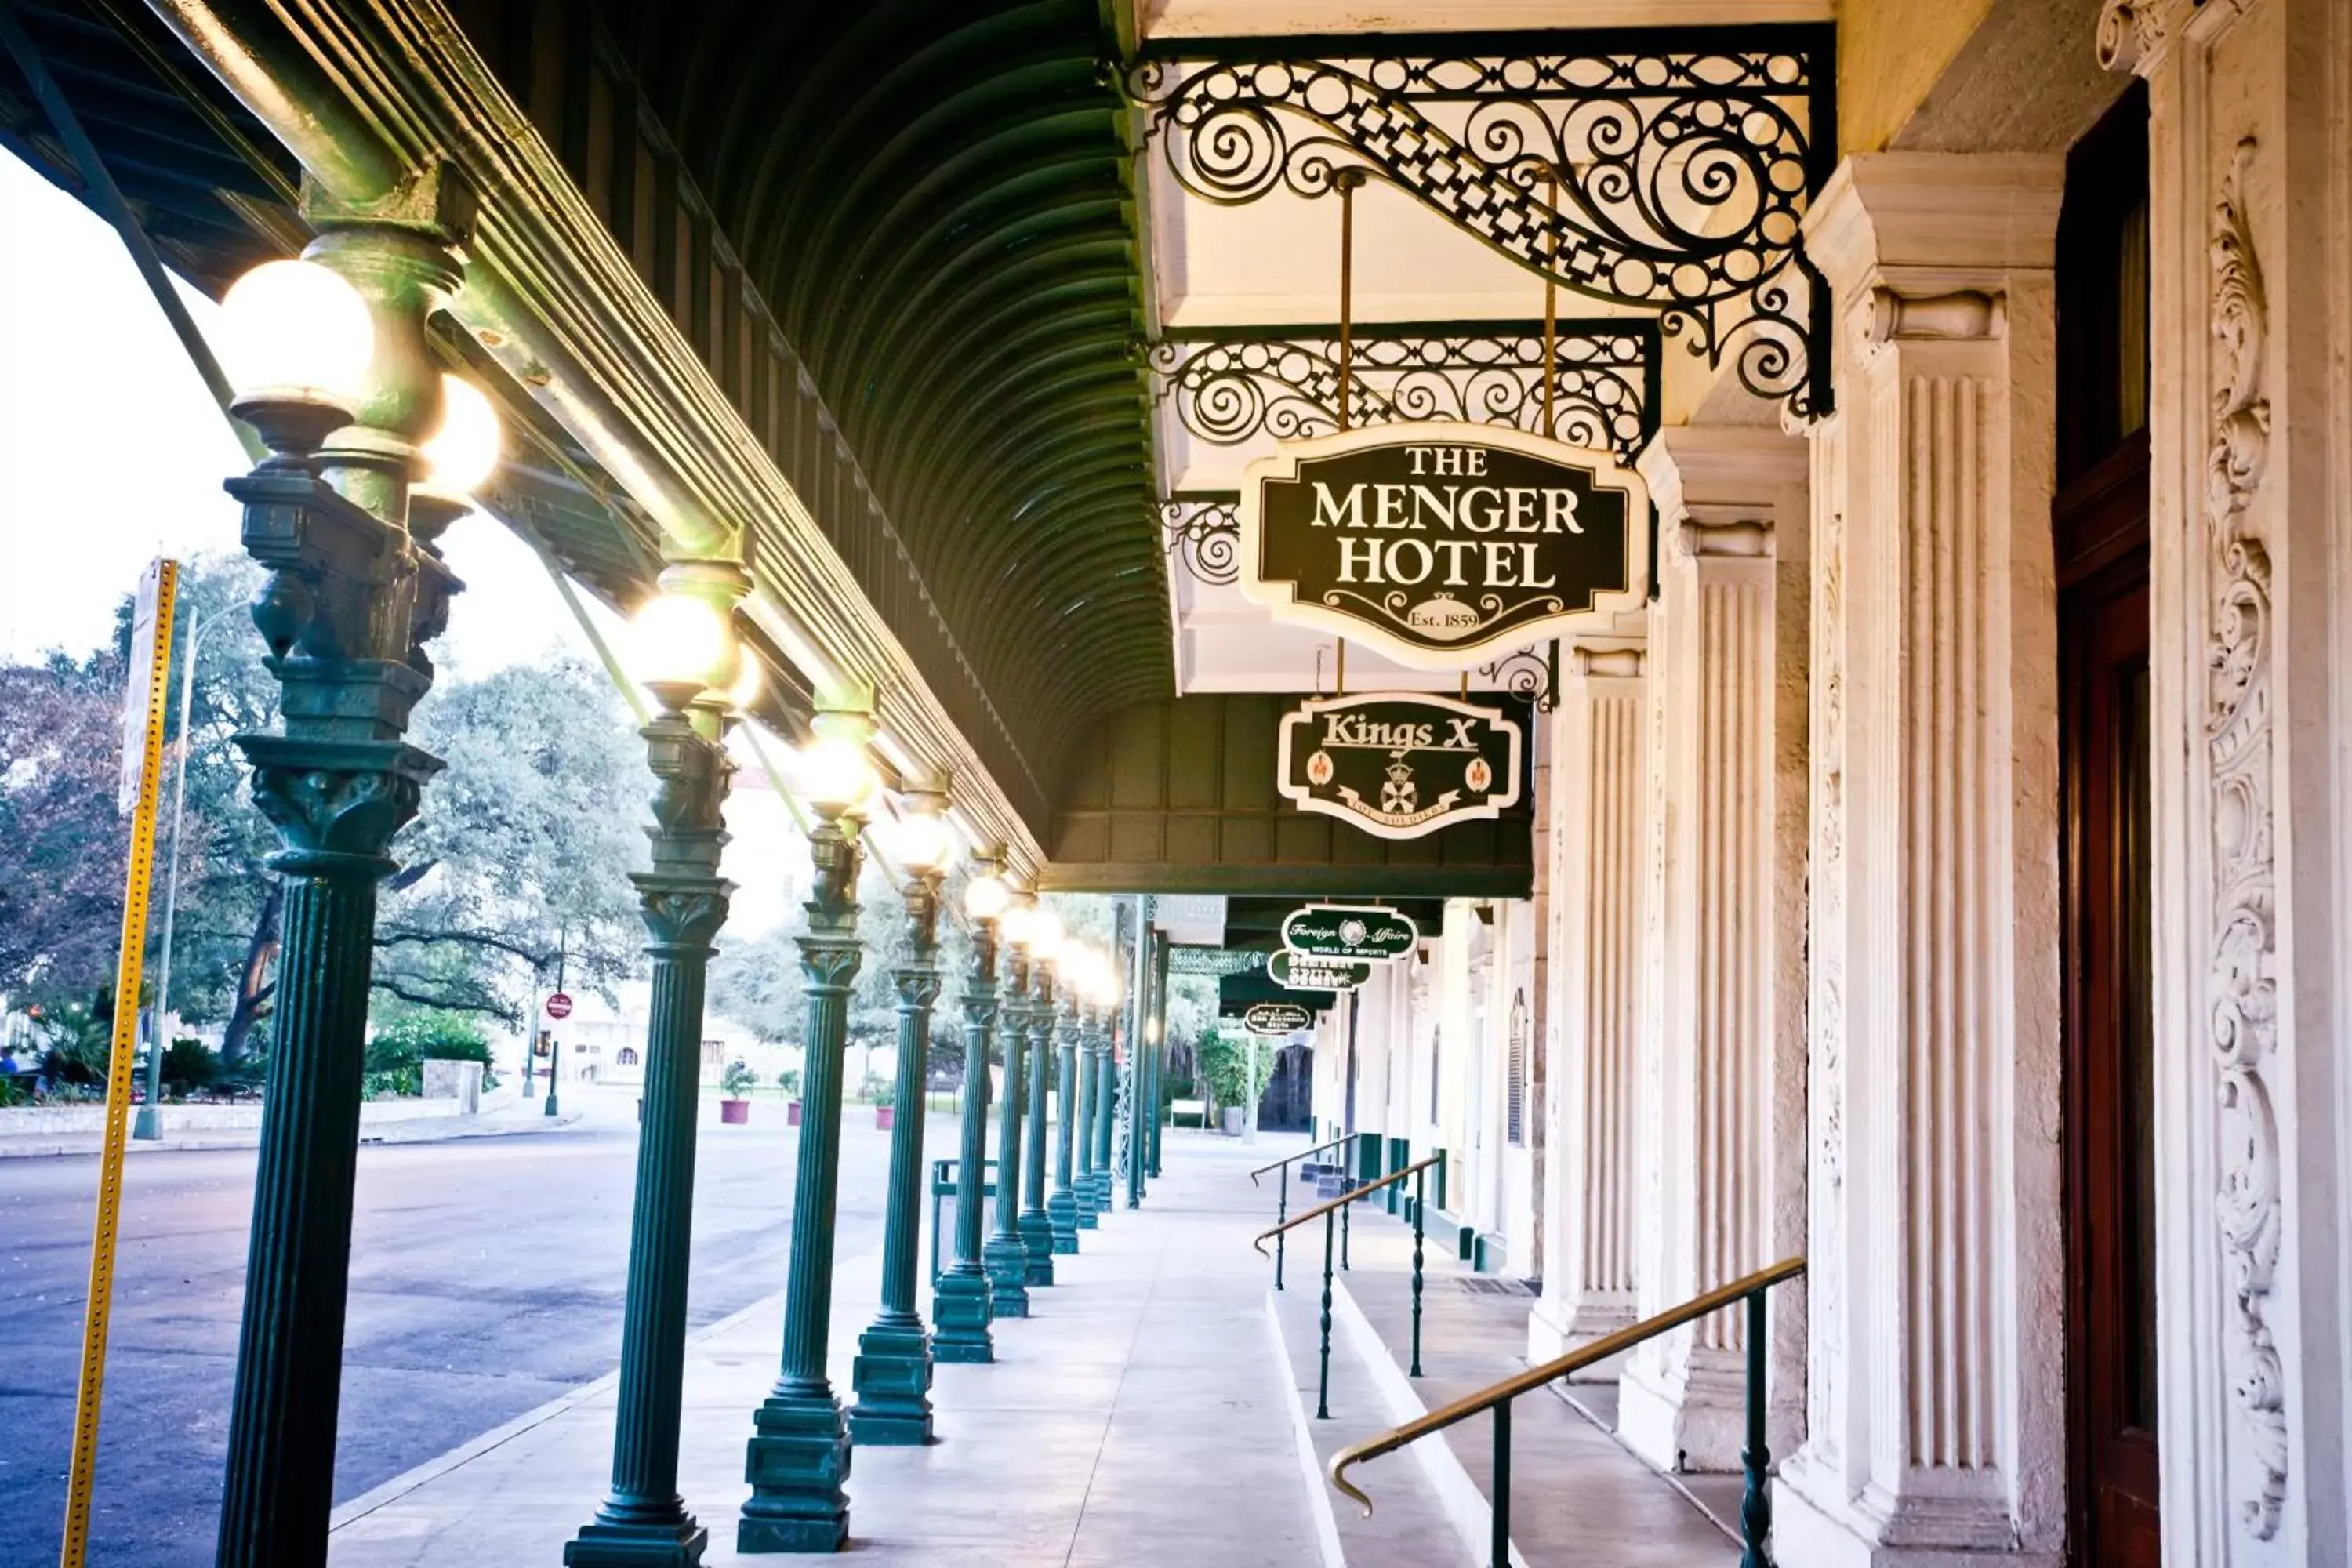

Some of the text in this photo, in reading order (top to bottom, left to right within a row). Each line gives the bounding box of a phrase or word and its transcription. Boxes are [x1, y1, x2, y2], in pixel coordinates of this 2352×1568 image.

[1405, 447, 1488, 477] THE
[1311, 482, 1584, 534] MENGER
[1335, 537, 1556, 588] HOTEL
[1410, 610, 1479, 629] Est. 1859
[1323, 713, 1479, 758] Kings X
[1290, 924, 1336, 941] Foreign
[1312, 946, 1339, 954] WORLD
